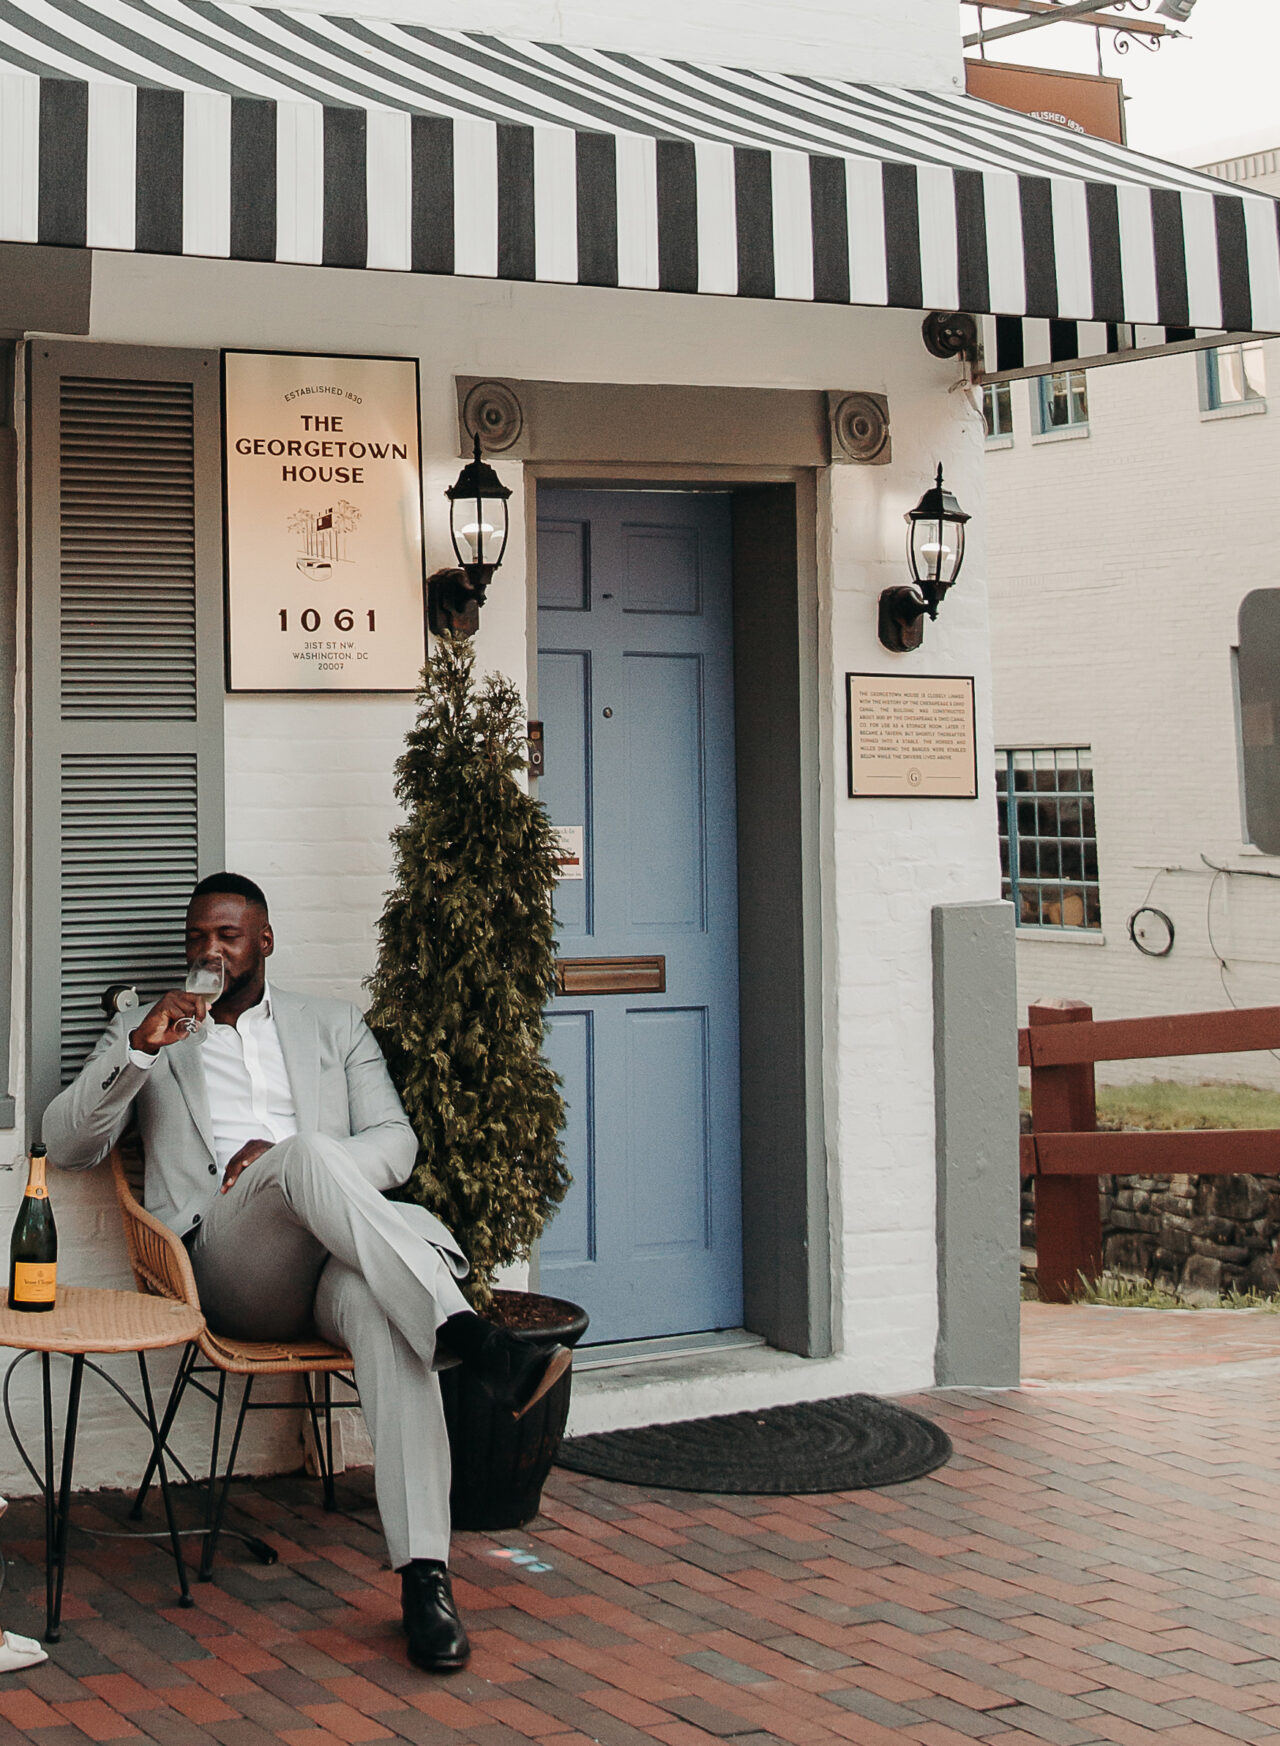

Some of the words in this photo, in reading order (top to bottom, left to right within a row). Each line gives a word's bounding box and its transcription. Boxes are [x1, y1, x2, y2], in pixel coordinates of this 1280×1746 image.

[1027, 111, 1066, 124] BLISHED
[284, 385, 343, 402] ESTABLISHED
[345, 391, 363, 405] 1830
[300, 415, 344, 432] THE
[235, 438, 407, 459] GEORGETOWN
[282, 465, 364, 484] HOUSE
[278, 608, 375, 632] 1061
[304, 641, 323, 649] 31ST
[326, 641, 337, 649] ST
[356, 652, 368, 660] DC
[318, 662, 344, 670] 20007
